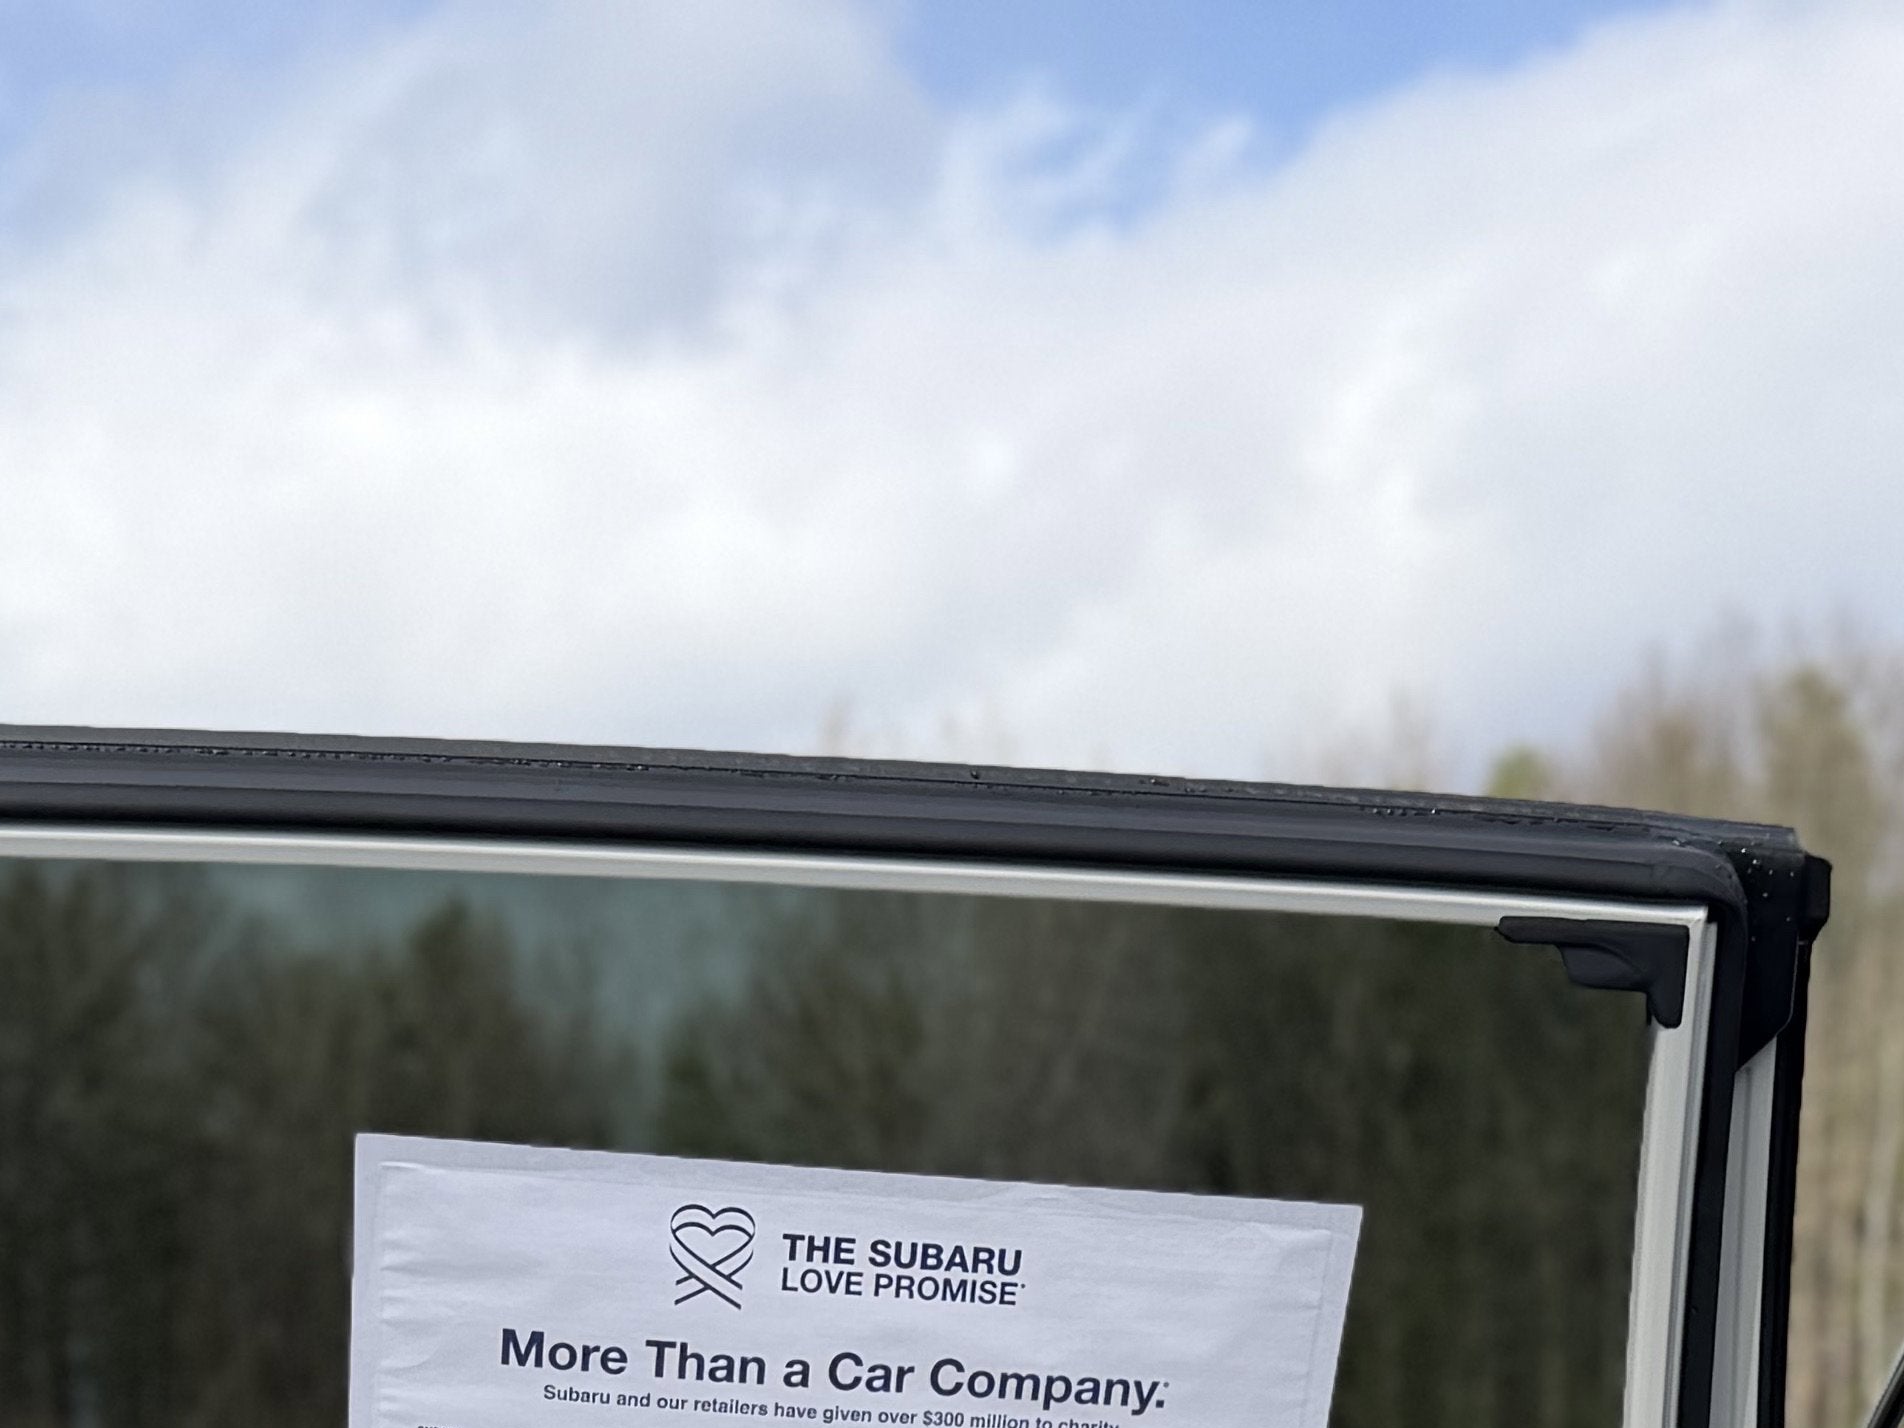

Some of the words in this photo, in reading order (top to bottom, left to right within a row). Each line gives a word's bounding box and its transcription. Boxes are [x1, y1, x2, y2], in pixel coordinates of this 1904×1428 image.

[781, 1232, 857, 1266] THE
[867, 1238, 1023, 1277] SUBARU
[780, 1266, 865, 1297] LOVE
[873, 1272, 1019, 1307] PROMISE
[500, 1327, 629, 1376] More
[644, 1339, 766, 1386] Than
[782, 1358, 811, 1389] a
[827, 1351, 916, 1394] Car
[543, 1384, 611, 1405] Subaru
[616, 1392, 651, 1408] and
[656, 1396, 689, 1411] our
[693, 1397, 769, 1417] retailers
[773, 1401, 818, 1420] have
[822, 1405, 873, 1425] given
[877, 1411, 919, 1425] over
[922, 1409, 965, 1428] $300
